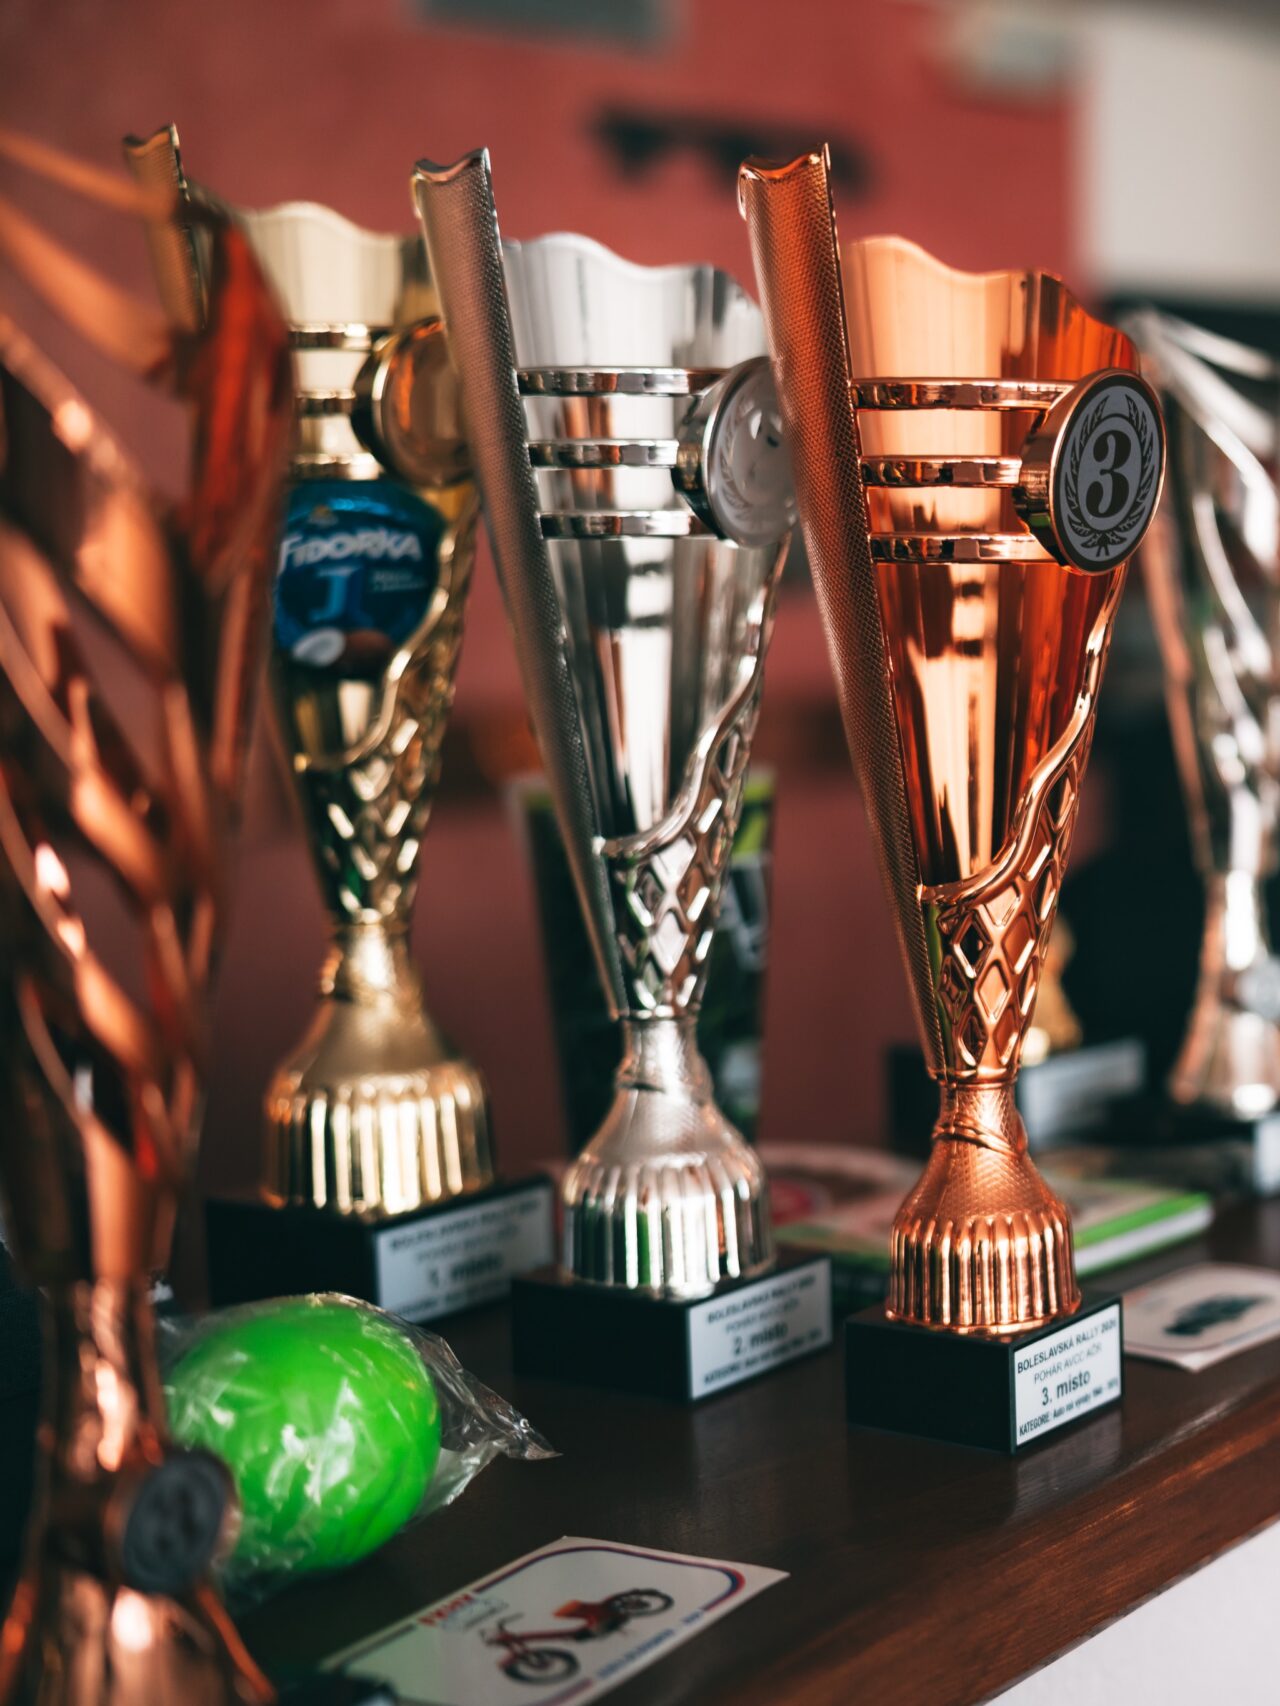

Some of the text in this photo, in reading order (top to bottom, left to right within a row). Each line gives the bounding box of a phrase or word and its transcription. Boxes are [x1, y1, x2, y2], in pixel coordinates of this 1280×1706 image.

[1086, 430, 1132, 518] 3
[1076, 1327, 1100, 1345] RALLY
[1041, 1387, 1052, 1406] 3.
